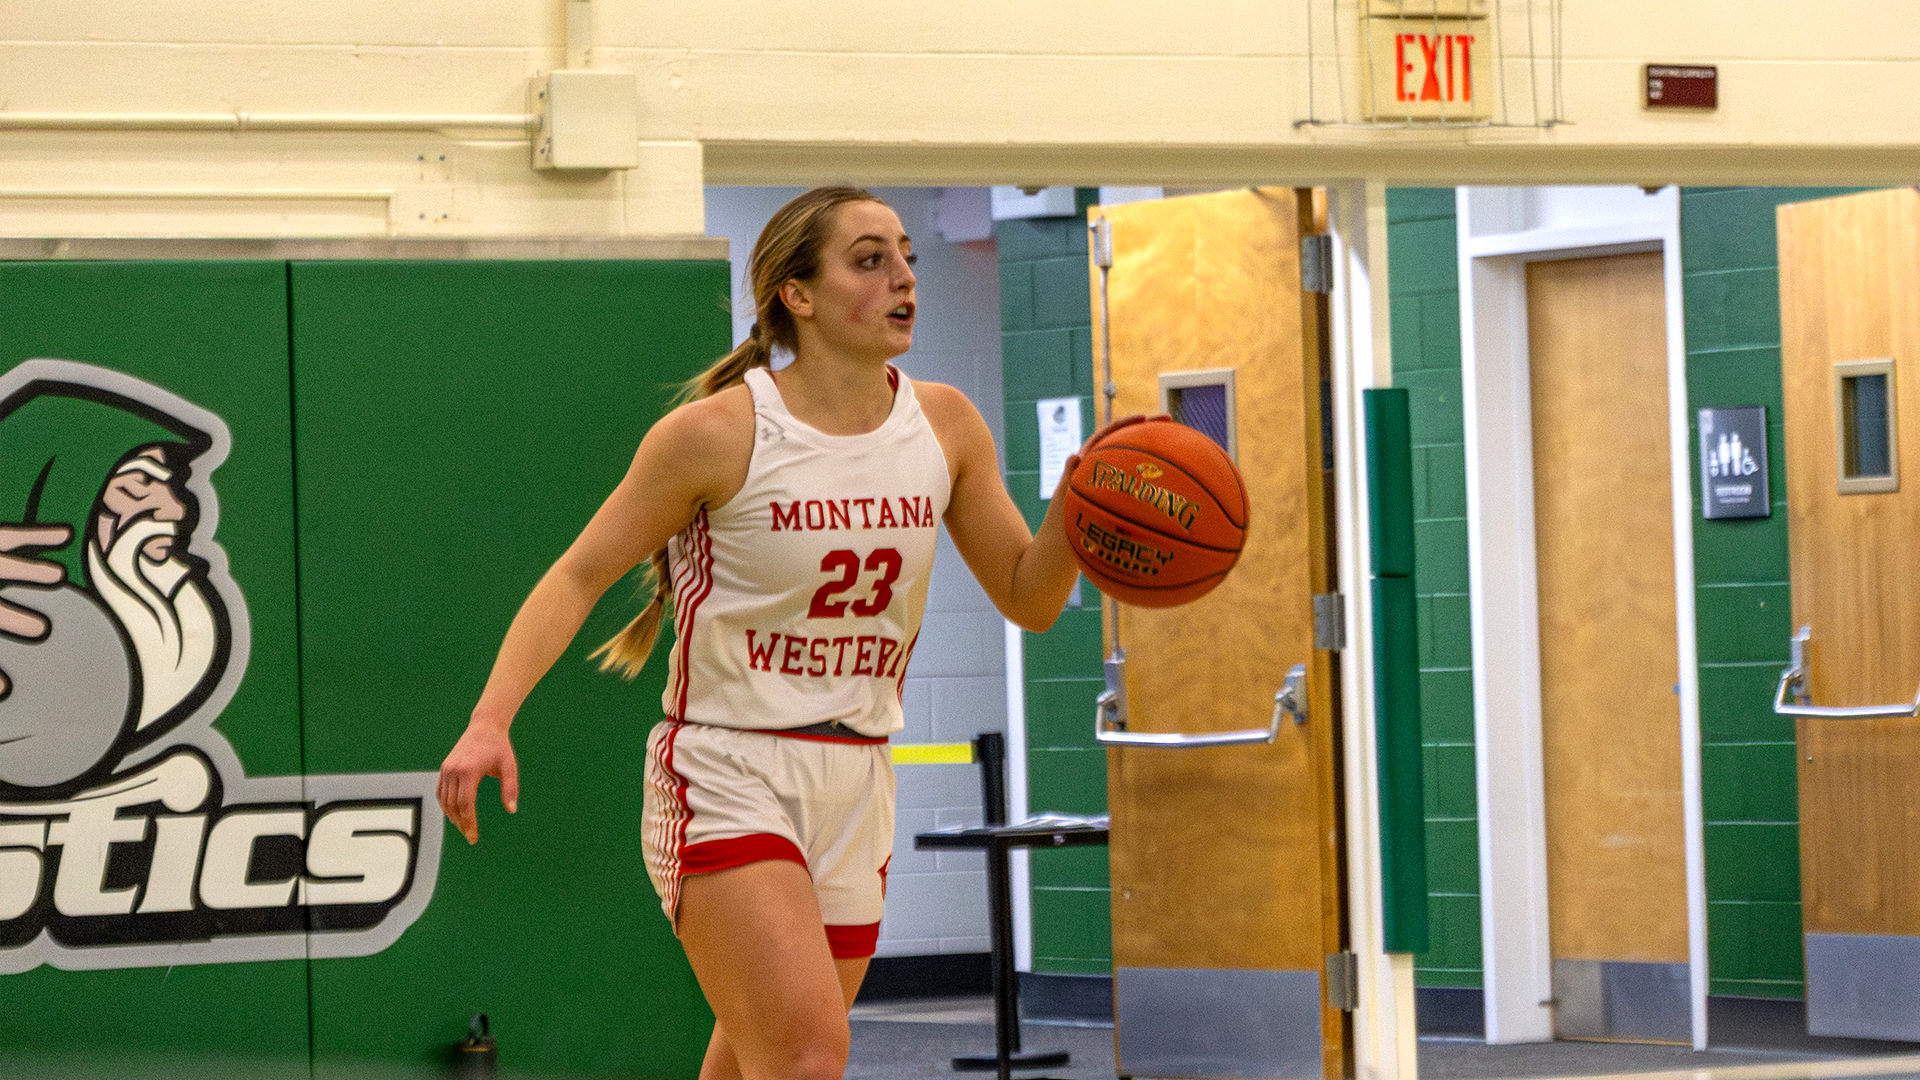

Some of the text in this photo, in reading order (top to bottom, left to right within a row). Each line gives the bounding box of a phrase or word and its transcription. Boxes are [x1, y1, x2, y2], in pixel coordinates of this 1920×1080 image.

[1395, 33, 1475, 102] EXIT
[770, 496, 934, 532] MONTANA
[1087, 461, 1200, 531] SPALDING
[1076, 512, 1174, 565] LEGACY
[807, 548, 902, 619] 23
